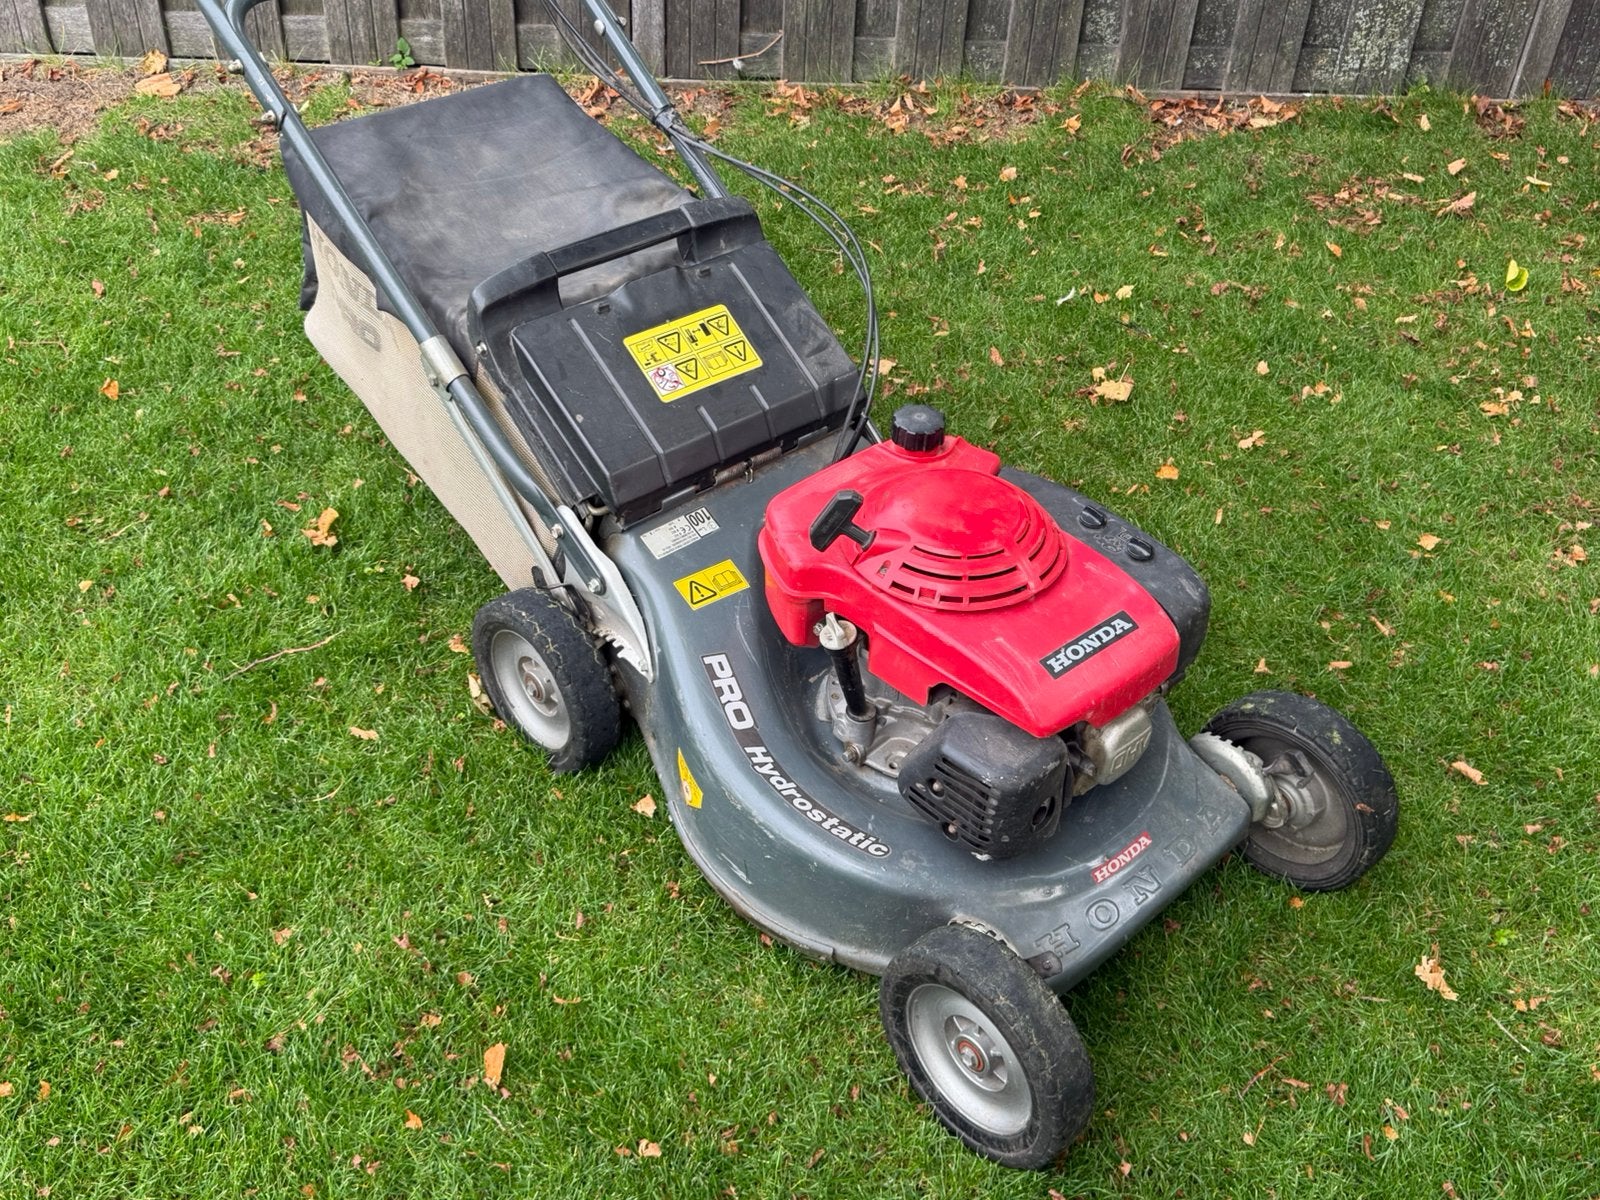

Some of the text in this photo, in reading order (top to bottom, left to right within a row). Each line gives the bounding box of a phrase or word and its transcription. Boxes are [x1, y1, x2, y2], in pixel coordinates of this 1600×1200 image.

[689, 509, 711, 527] 100
[1046, 618, 1133, 673] HONDA
[703, 653, 889, 857] PRO Hydrostatic
[1034, 804, 1232, 959] HONDA
[1093, 835, 1152, 884] HONDA
